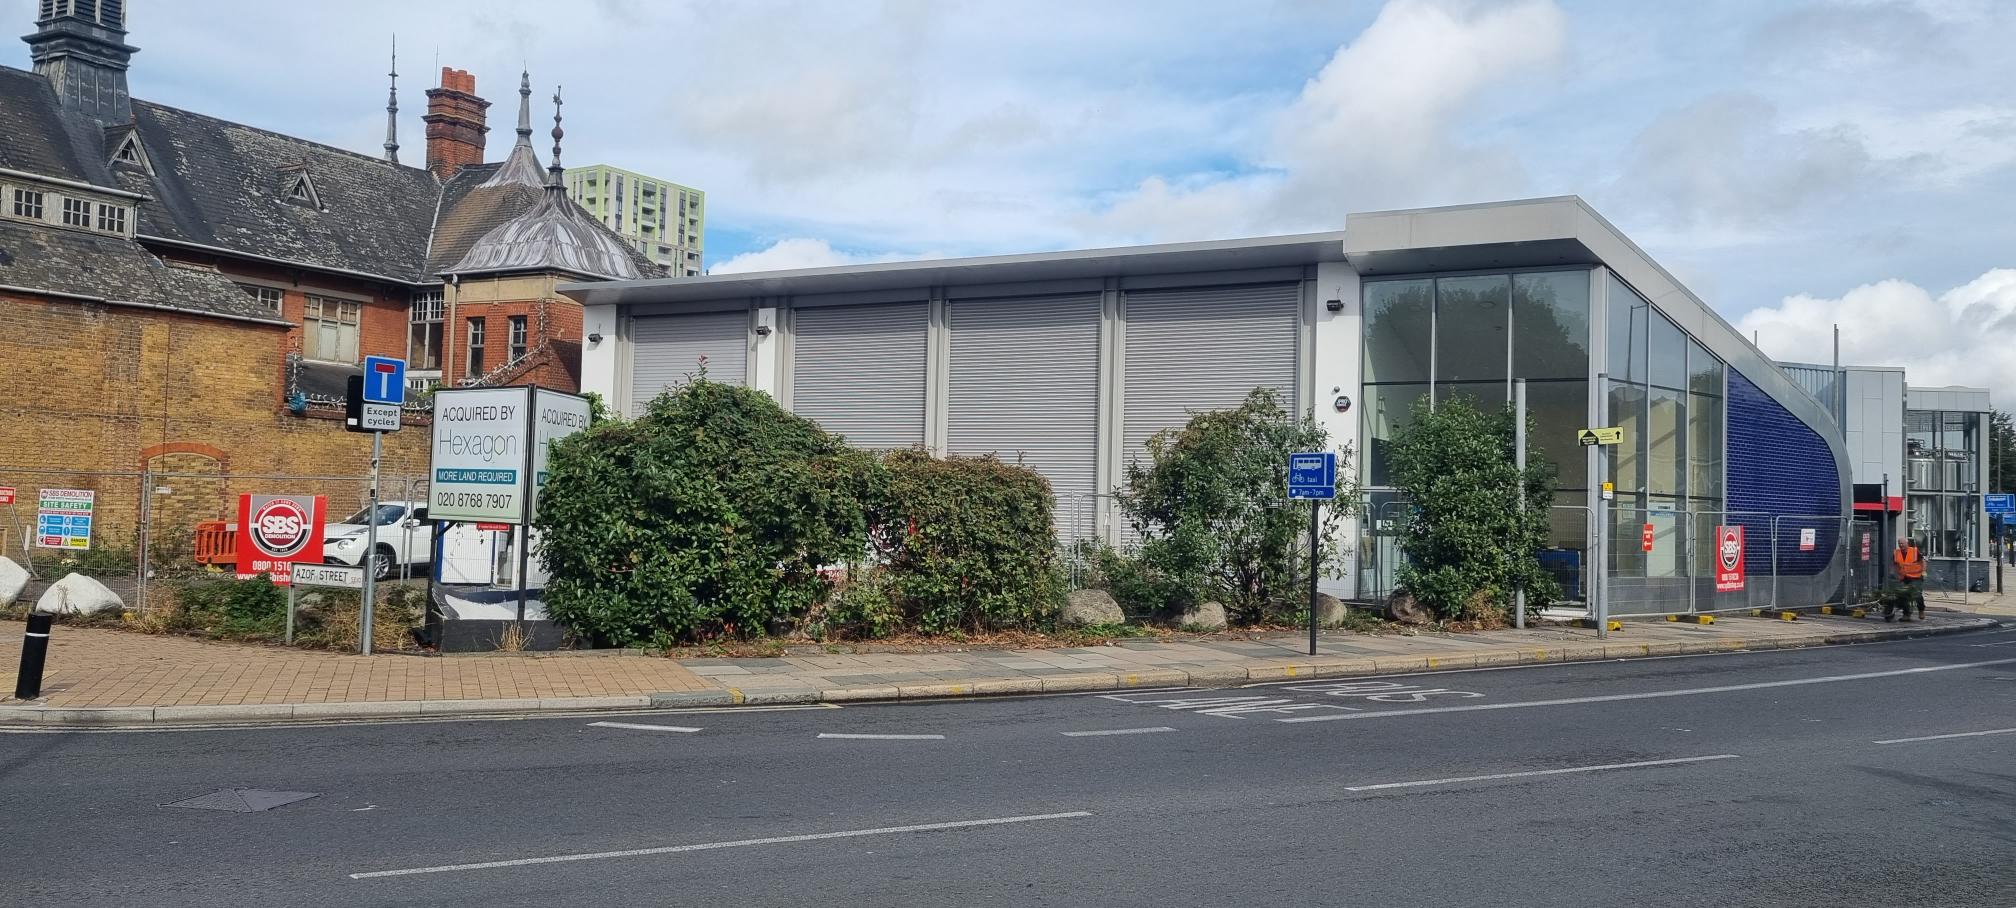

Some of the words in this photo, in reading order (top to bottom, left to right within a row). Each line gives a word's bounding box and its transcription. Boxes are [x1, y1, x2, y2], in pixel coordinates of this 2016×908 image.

[366, 407, 398, 417] Except
[441, 406, 498, 422] ACQUIRED
[500, 405, 516, 421] BY
[541, 407, 577, 428] ACQUIRED
[578, 413, 588, 430] BY
[367, 417, 396, 426] cycles
[438, 428, 517, 463] Hexagon
[438, 470, 458, 481] MORE
[458, 471, 477, 481] LAND
[478, 472, 514, 482] REQUIRED
[1307, 475, 1318, 483] taxi
[60, 490, 92, 498] DEMOLITION
[1298, 488, 1325, 496] 7am-7pm
[60, 501, 87, 509] SAFETY
[437, 492, 455, 507] 020
[457, 492, 483, 508] 8768
[486, 493, 512, 509] 7907
[263, 515, 299, 534] SBS
[1724, 540, 1738, 554] SBS
[252, 560, 272, 571] 0800
[295, 568, 316, 581] AZOF
[319, 569, 349, 582] STREET
[1280, 681, 1486, 702] BUS
[1095, 688, 1363, 720] LANE
